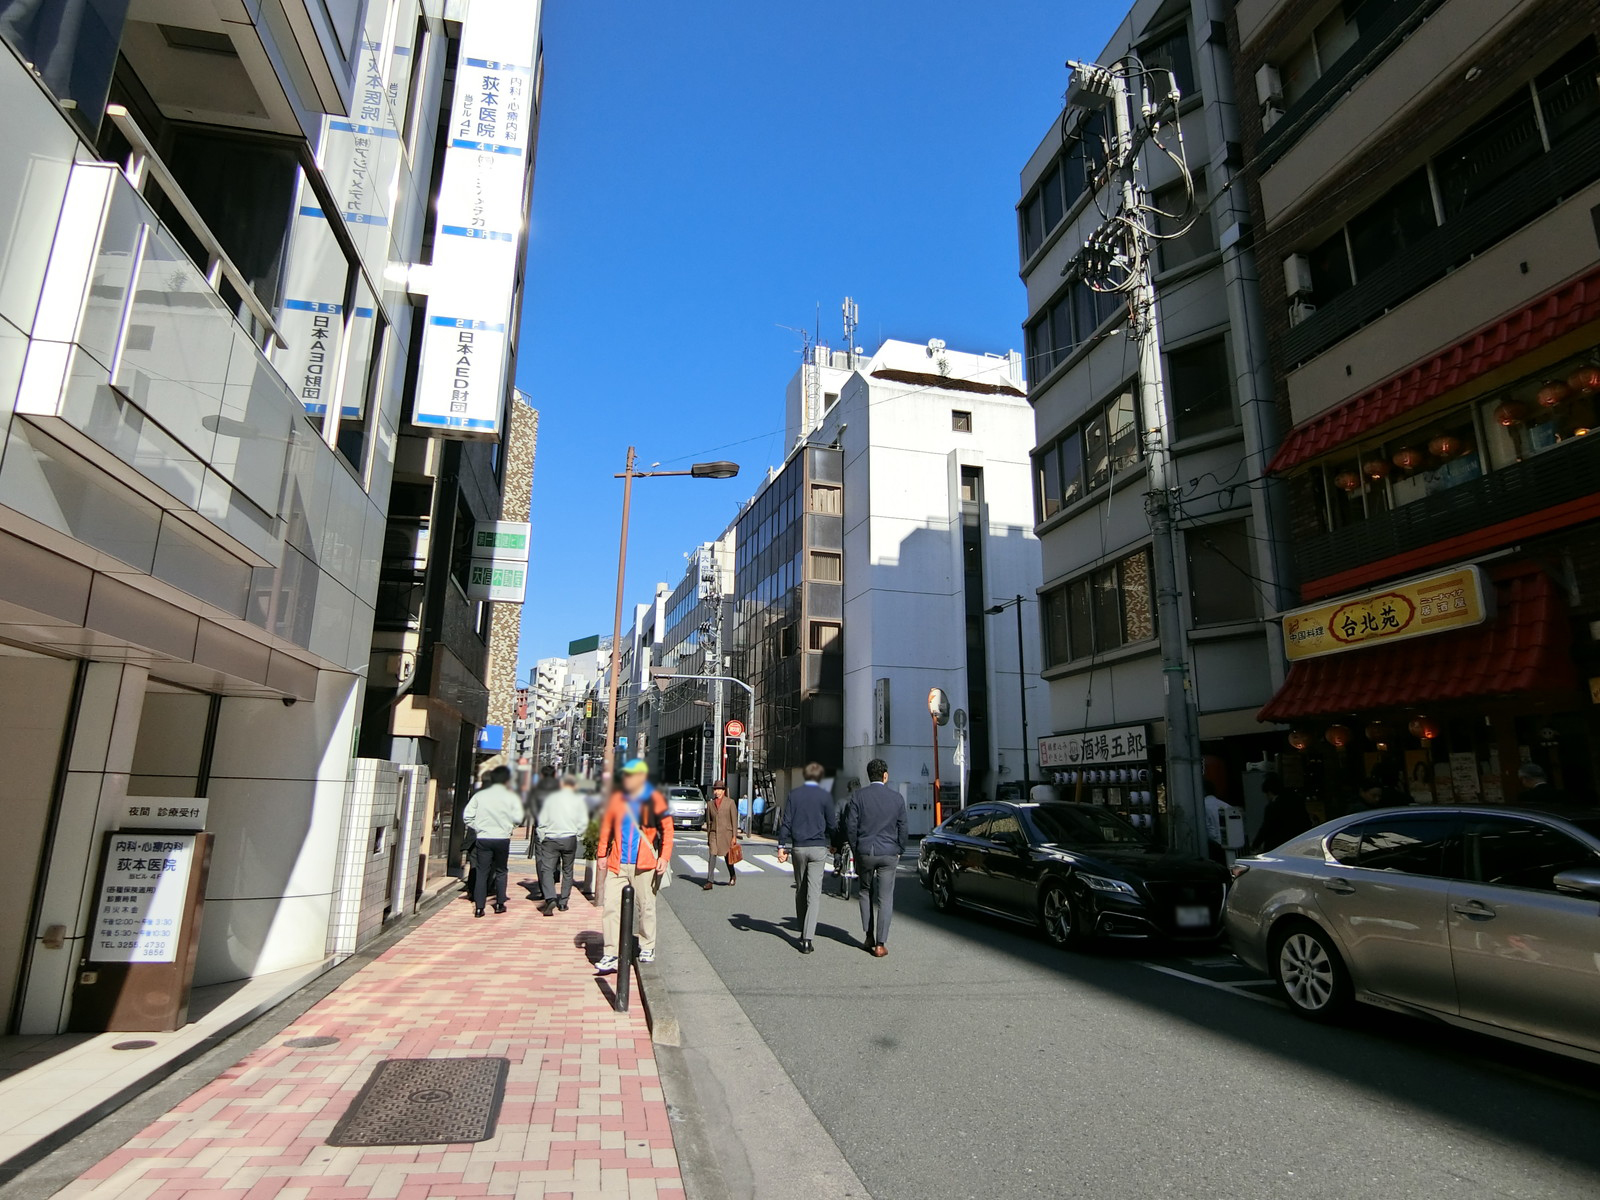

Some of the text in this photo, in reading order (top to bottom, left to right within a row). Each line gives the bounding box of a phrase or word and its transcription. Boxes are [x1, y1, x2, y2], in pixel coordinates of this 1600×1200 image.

[477, 75, 500, 138] 荻本医院
[450, 331, 474, 413] 日本AED財団
[1421, 598, 1467, 617] 居酒屋
[1341, 605, 1400, 638] 台北苑
[1289, 626, 1325, 642] 中国料理
[1081, 732, 1147, 761] 酒場五郎
[128, 806, 200, 818] 夜間 診療受付
[116, 841, 184, 853] 内科・心療内科
[117, 858, 177, 872] 荻本医院
[101, 941, 115, 949] TEL
[144, 941, 166, 949] 4730
